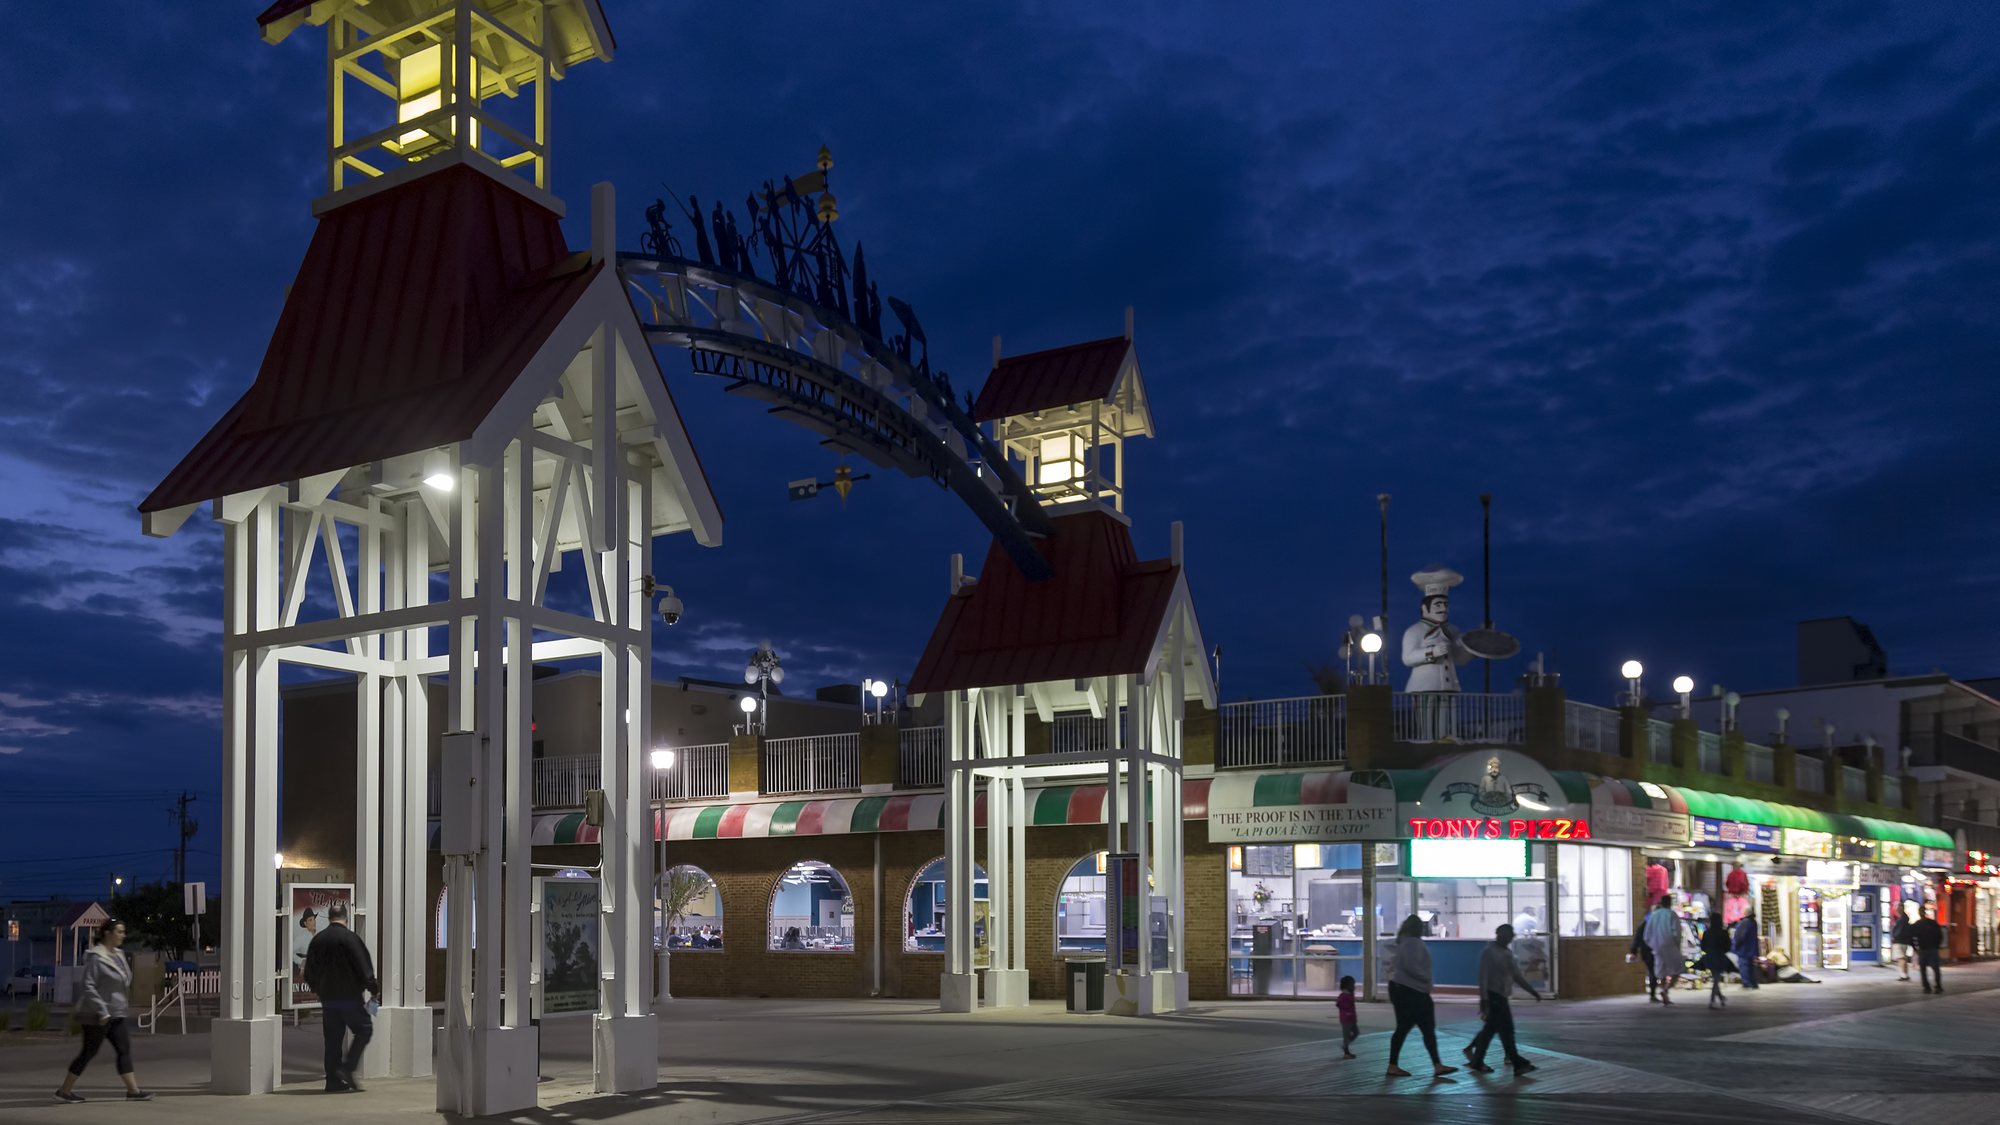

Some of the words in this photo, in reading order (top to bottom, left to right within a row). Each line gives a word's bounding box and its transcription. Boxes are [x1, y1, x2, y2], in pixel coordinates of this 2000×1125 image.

[1212, 812, 1243, 825] "THE
[1246, 811, 1287, 824] PROOF
[1289, 810, 1300, 822] IS
[1303, 810, 1316, 822] IN
[1318, 809, 1344, 821] THE
[1346, 807, 1393, 820] TASTE"
[1509, 817, 1591, 839] PIZZA
[83, 917, 102, 925] PARKI
